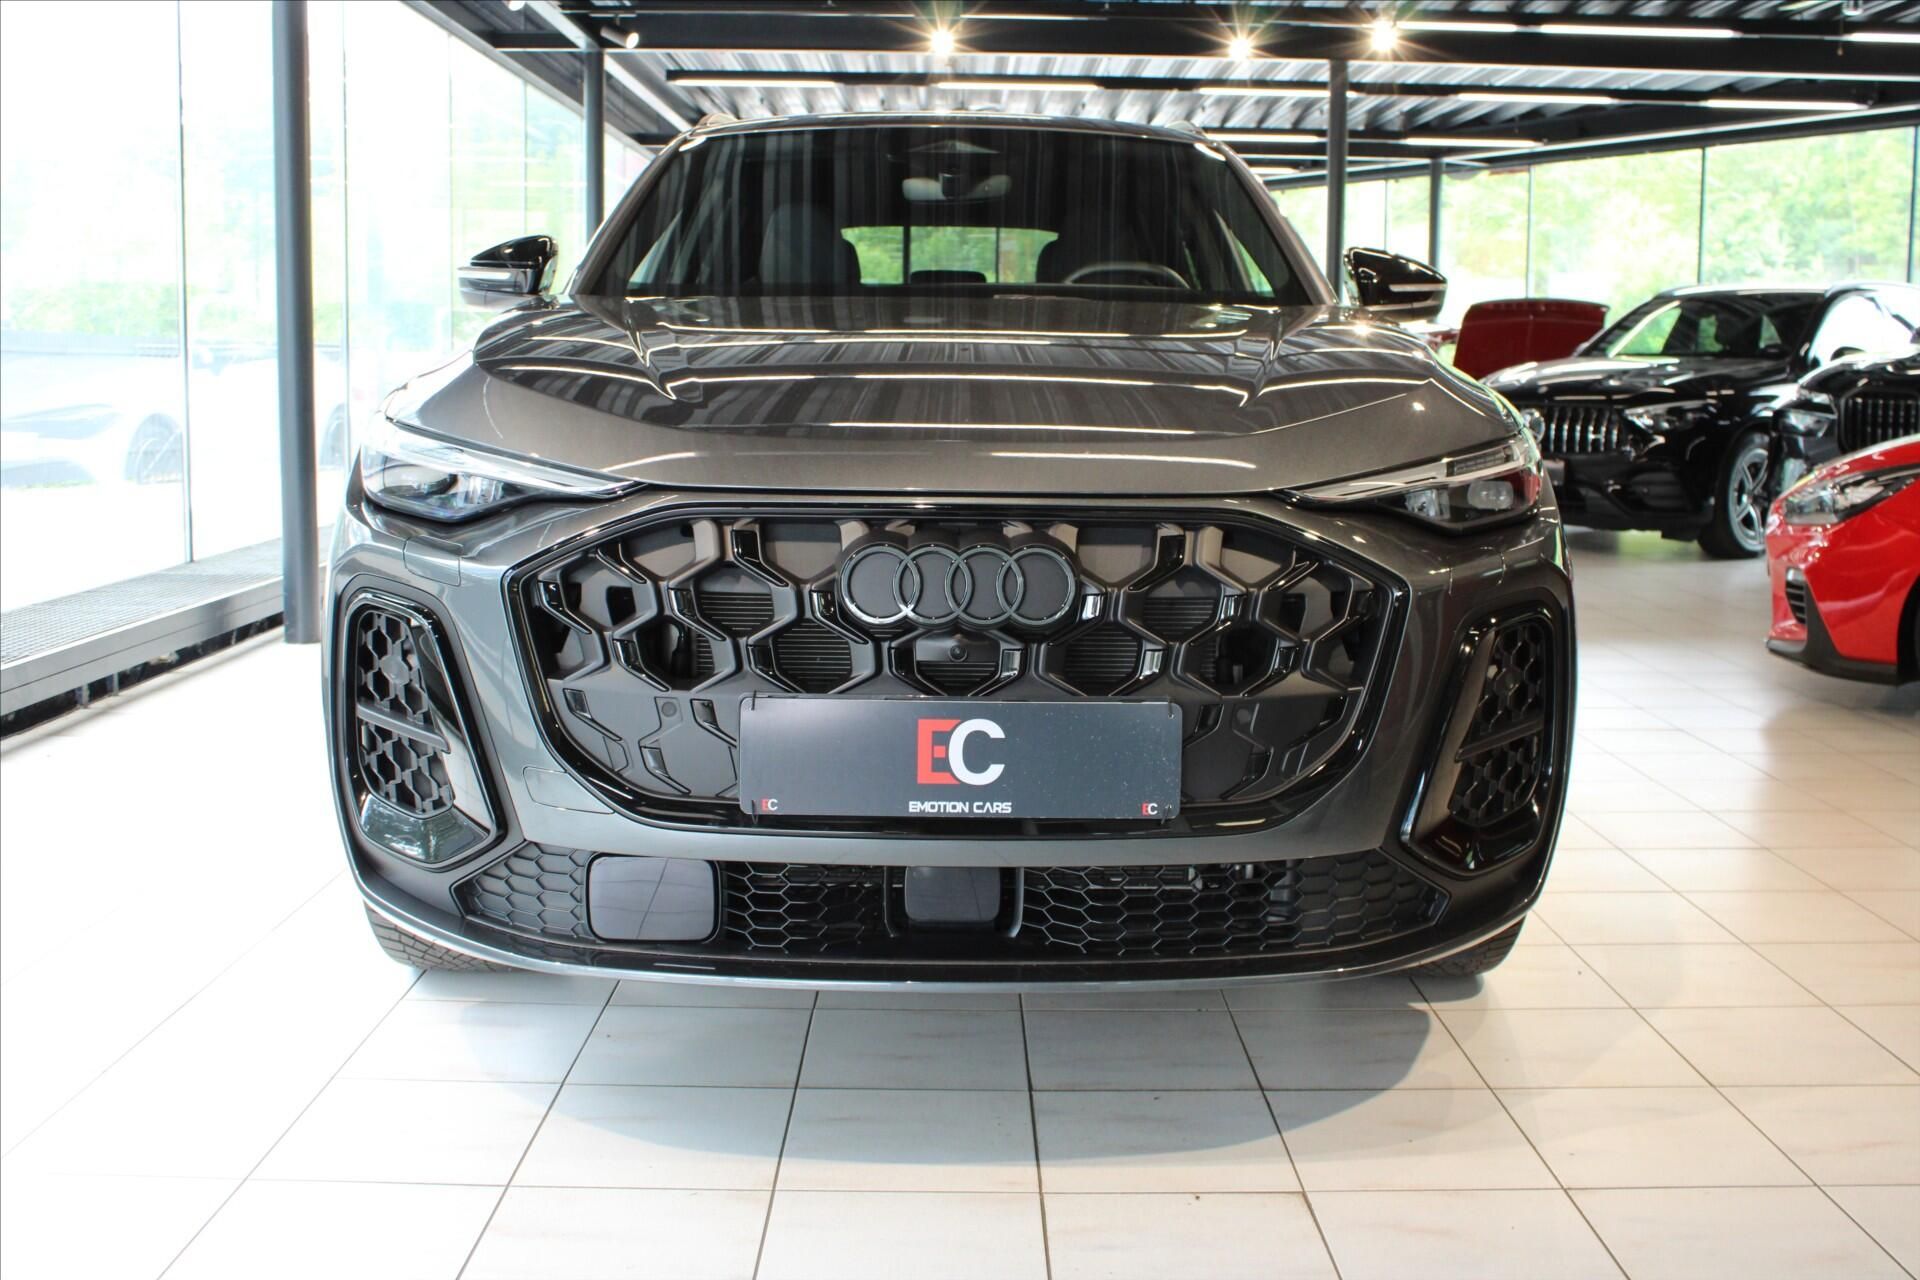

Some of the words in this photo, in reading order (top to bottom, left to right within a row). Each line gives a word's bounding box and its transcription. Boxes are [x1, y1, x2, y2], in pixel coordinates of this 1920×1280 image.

[917, 718, 1006, 786] EC
[761, 798, 778, 811] EC
[908, 801, 969, 813] EMOTION
[973, 801, 1012, 814] CARS
[1142, 803, 1158, 816] EC
